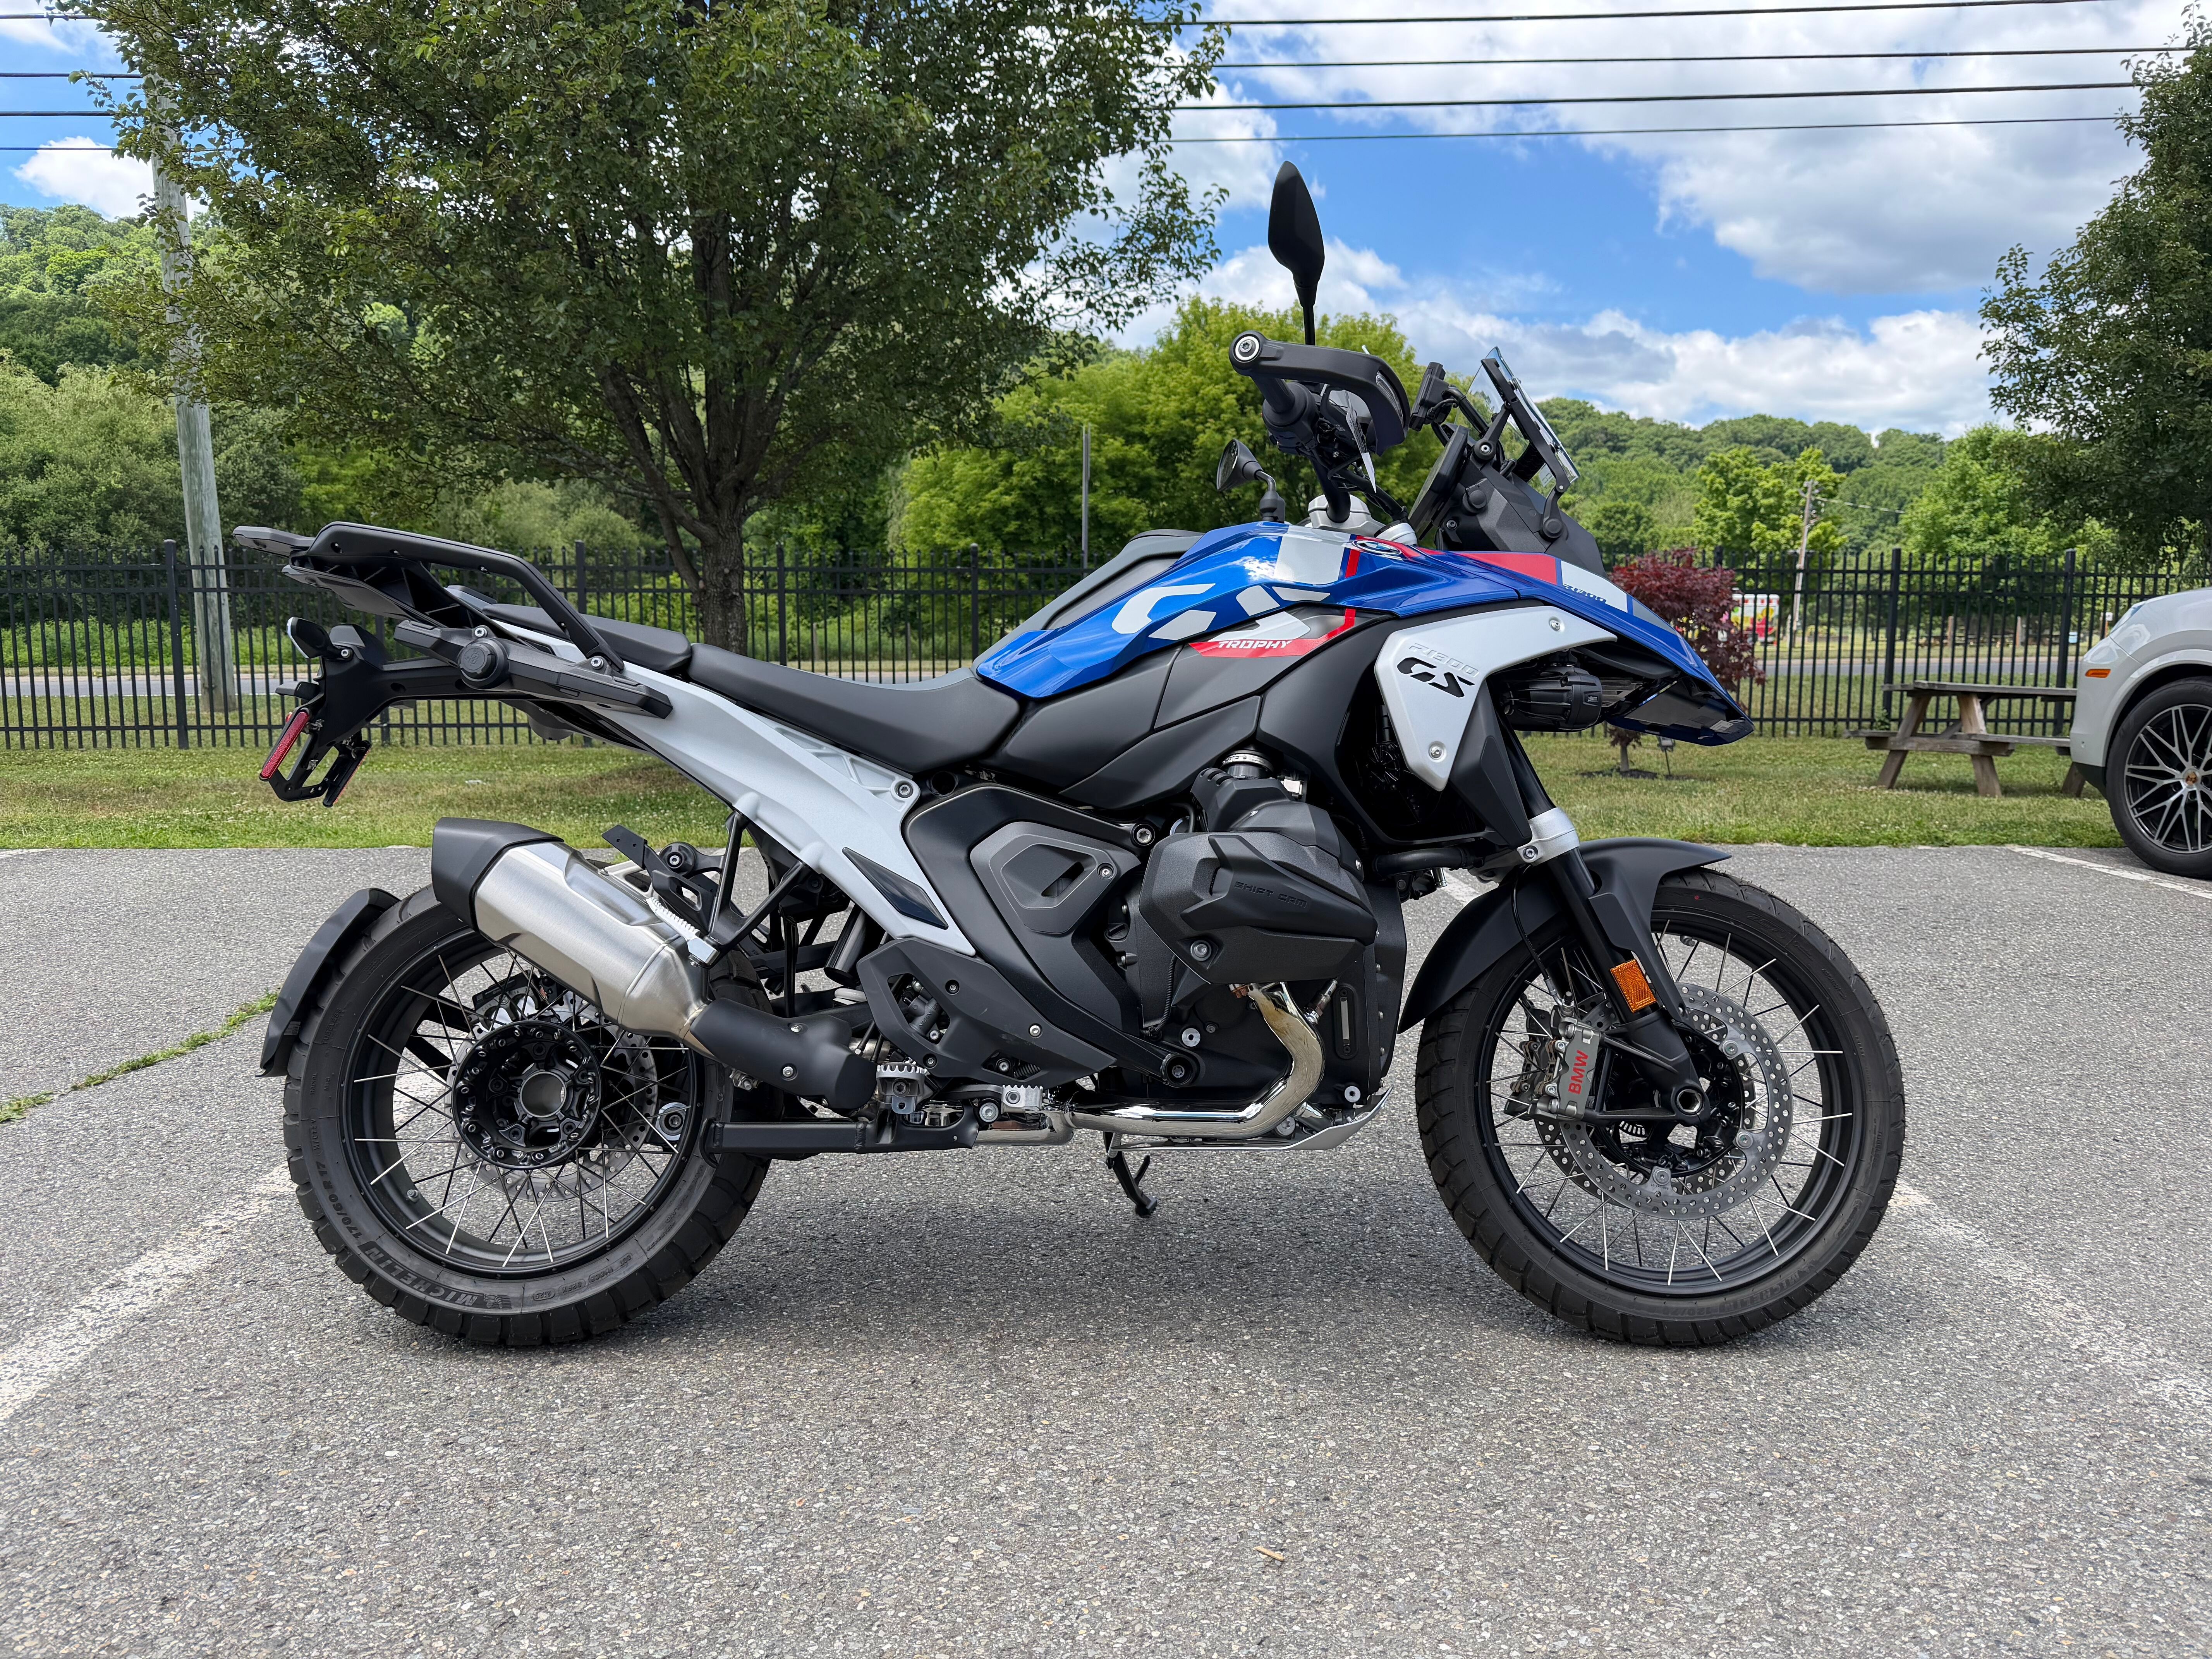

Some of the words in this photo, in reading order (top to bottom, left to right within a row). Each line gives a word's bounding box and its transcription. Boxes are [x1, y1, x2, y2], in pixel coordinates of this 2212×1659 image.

[1218, 641, 1293, 649] TROPHY
[1409, 643, 1479, 677] R1300
[1397, 657, 1475, 697] GS
[1234, 881, 1274, 897] SHIFT
[1278, 893, 1307, 908] CAM
[1568, 1049, 1589, 1094] BMW
[315, 1159, 328, 1176] 17
[321, 1178, 333, 1191] R
[327, 1192, 363, 1240] 170/60
[365, 1245, 477, 1305] MICHELIN
